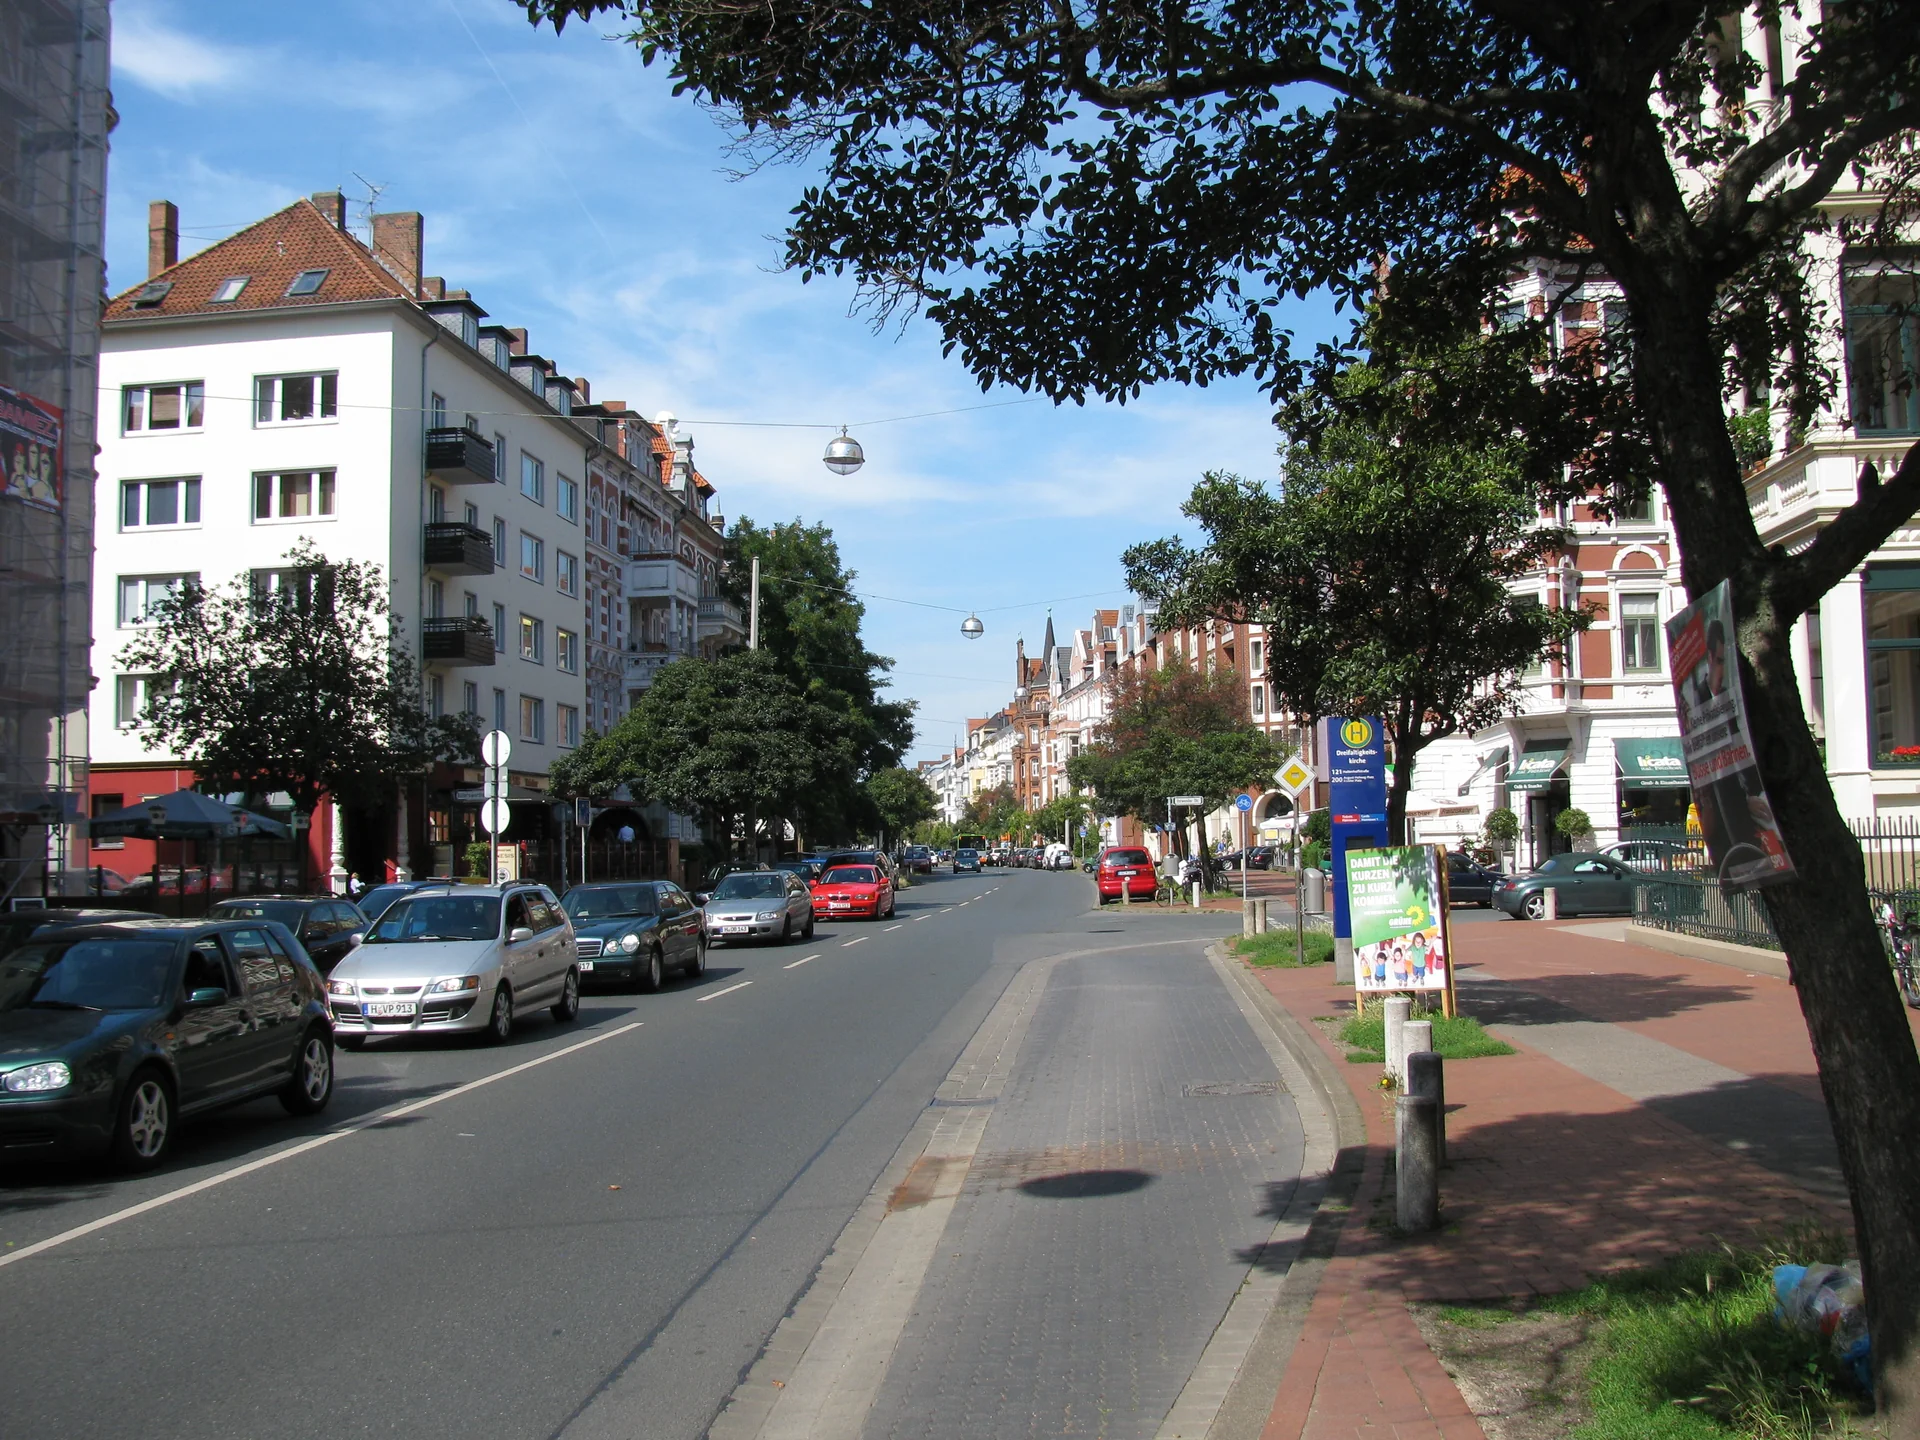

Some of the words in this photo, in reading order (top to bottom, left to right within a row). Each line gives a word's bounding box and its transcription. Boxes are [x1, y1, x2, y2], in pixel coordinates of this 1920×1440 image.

[1336, 749, 1378, 757] Dreifaltigkeits-
[1637, 755, 1682, 767] licata
[1691, 761, 1710, 780] Busse
[1710, 755, 1722, 772] und
[1721, 744, 1751, 769] Bahnen.
[1350, 856, 1381, 869] DAMIT
[1383, 855, 1399, 866] DIE
[1770, 854, 1784, 868] SPD
[1351, 869, 1390, 882] KURZEN
[1352, 884, 1366, 894] ZU
[1367, 882, 1393, 893] KURZ
[1353, 895, 1400, 907] KOMMEN.
[1388, 916, 1412, 927] GRÜNE
[396, 1004, 413, 1013] 913
